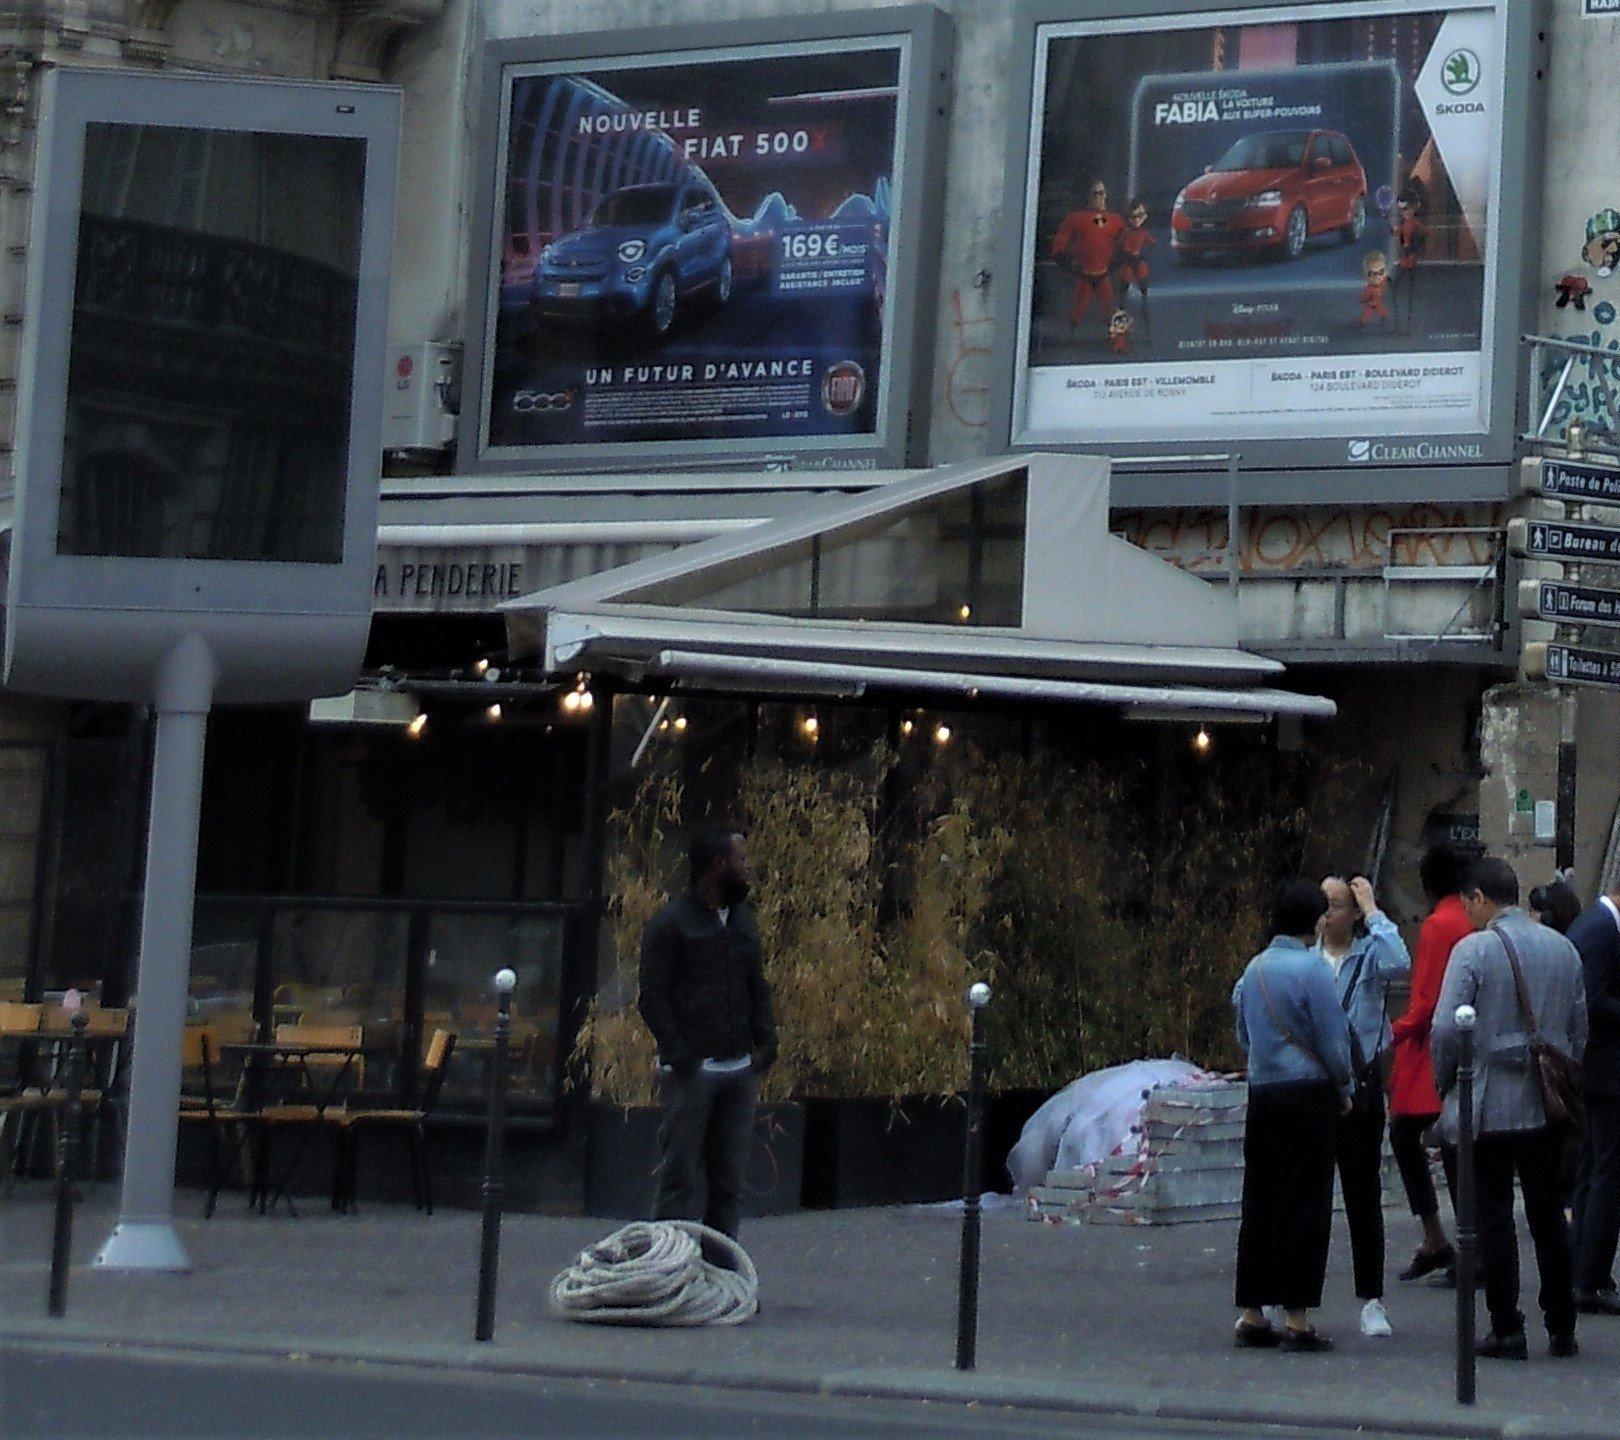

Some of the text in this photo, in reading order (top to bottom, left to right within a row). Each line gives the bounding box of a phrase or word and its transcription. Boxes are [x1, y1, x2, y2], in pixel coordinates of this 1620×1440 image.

[579, 108, 701, 134] NOUVELLE
[1155, 101, 1220, 125] FABIA
[684, 134, 744, 160] FIAT
[585, 359, 813, 384] UN FUTUR D'AVANCE
[1559, 471, 1585, 490] Poste
[1588, 474, 1600, 491] de
[1563, 532, 1606, 554] Bureau
[374, 563, 522, 595] A PENDERIE
[1570, 595, 1596, 612] Forum
[1598, 598, 1612, 614] des
